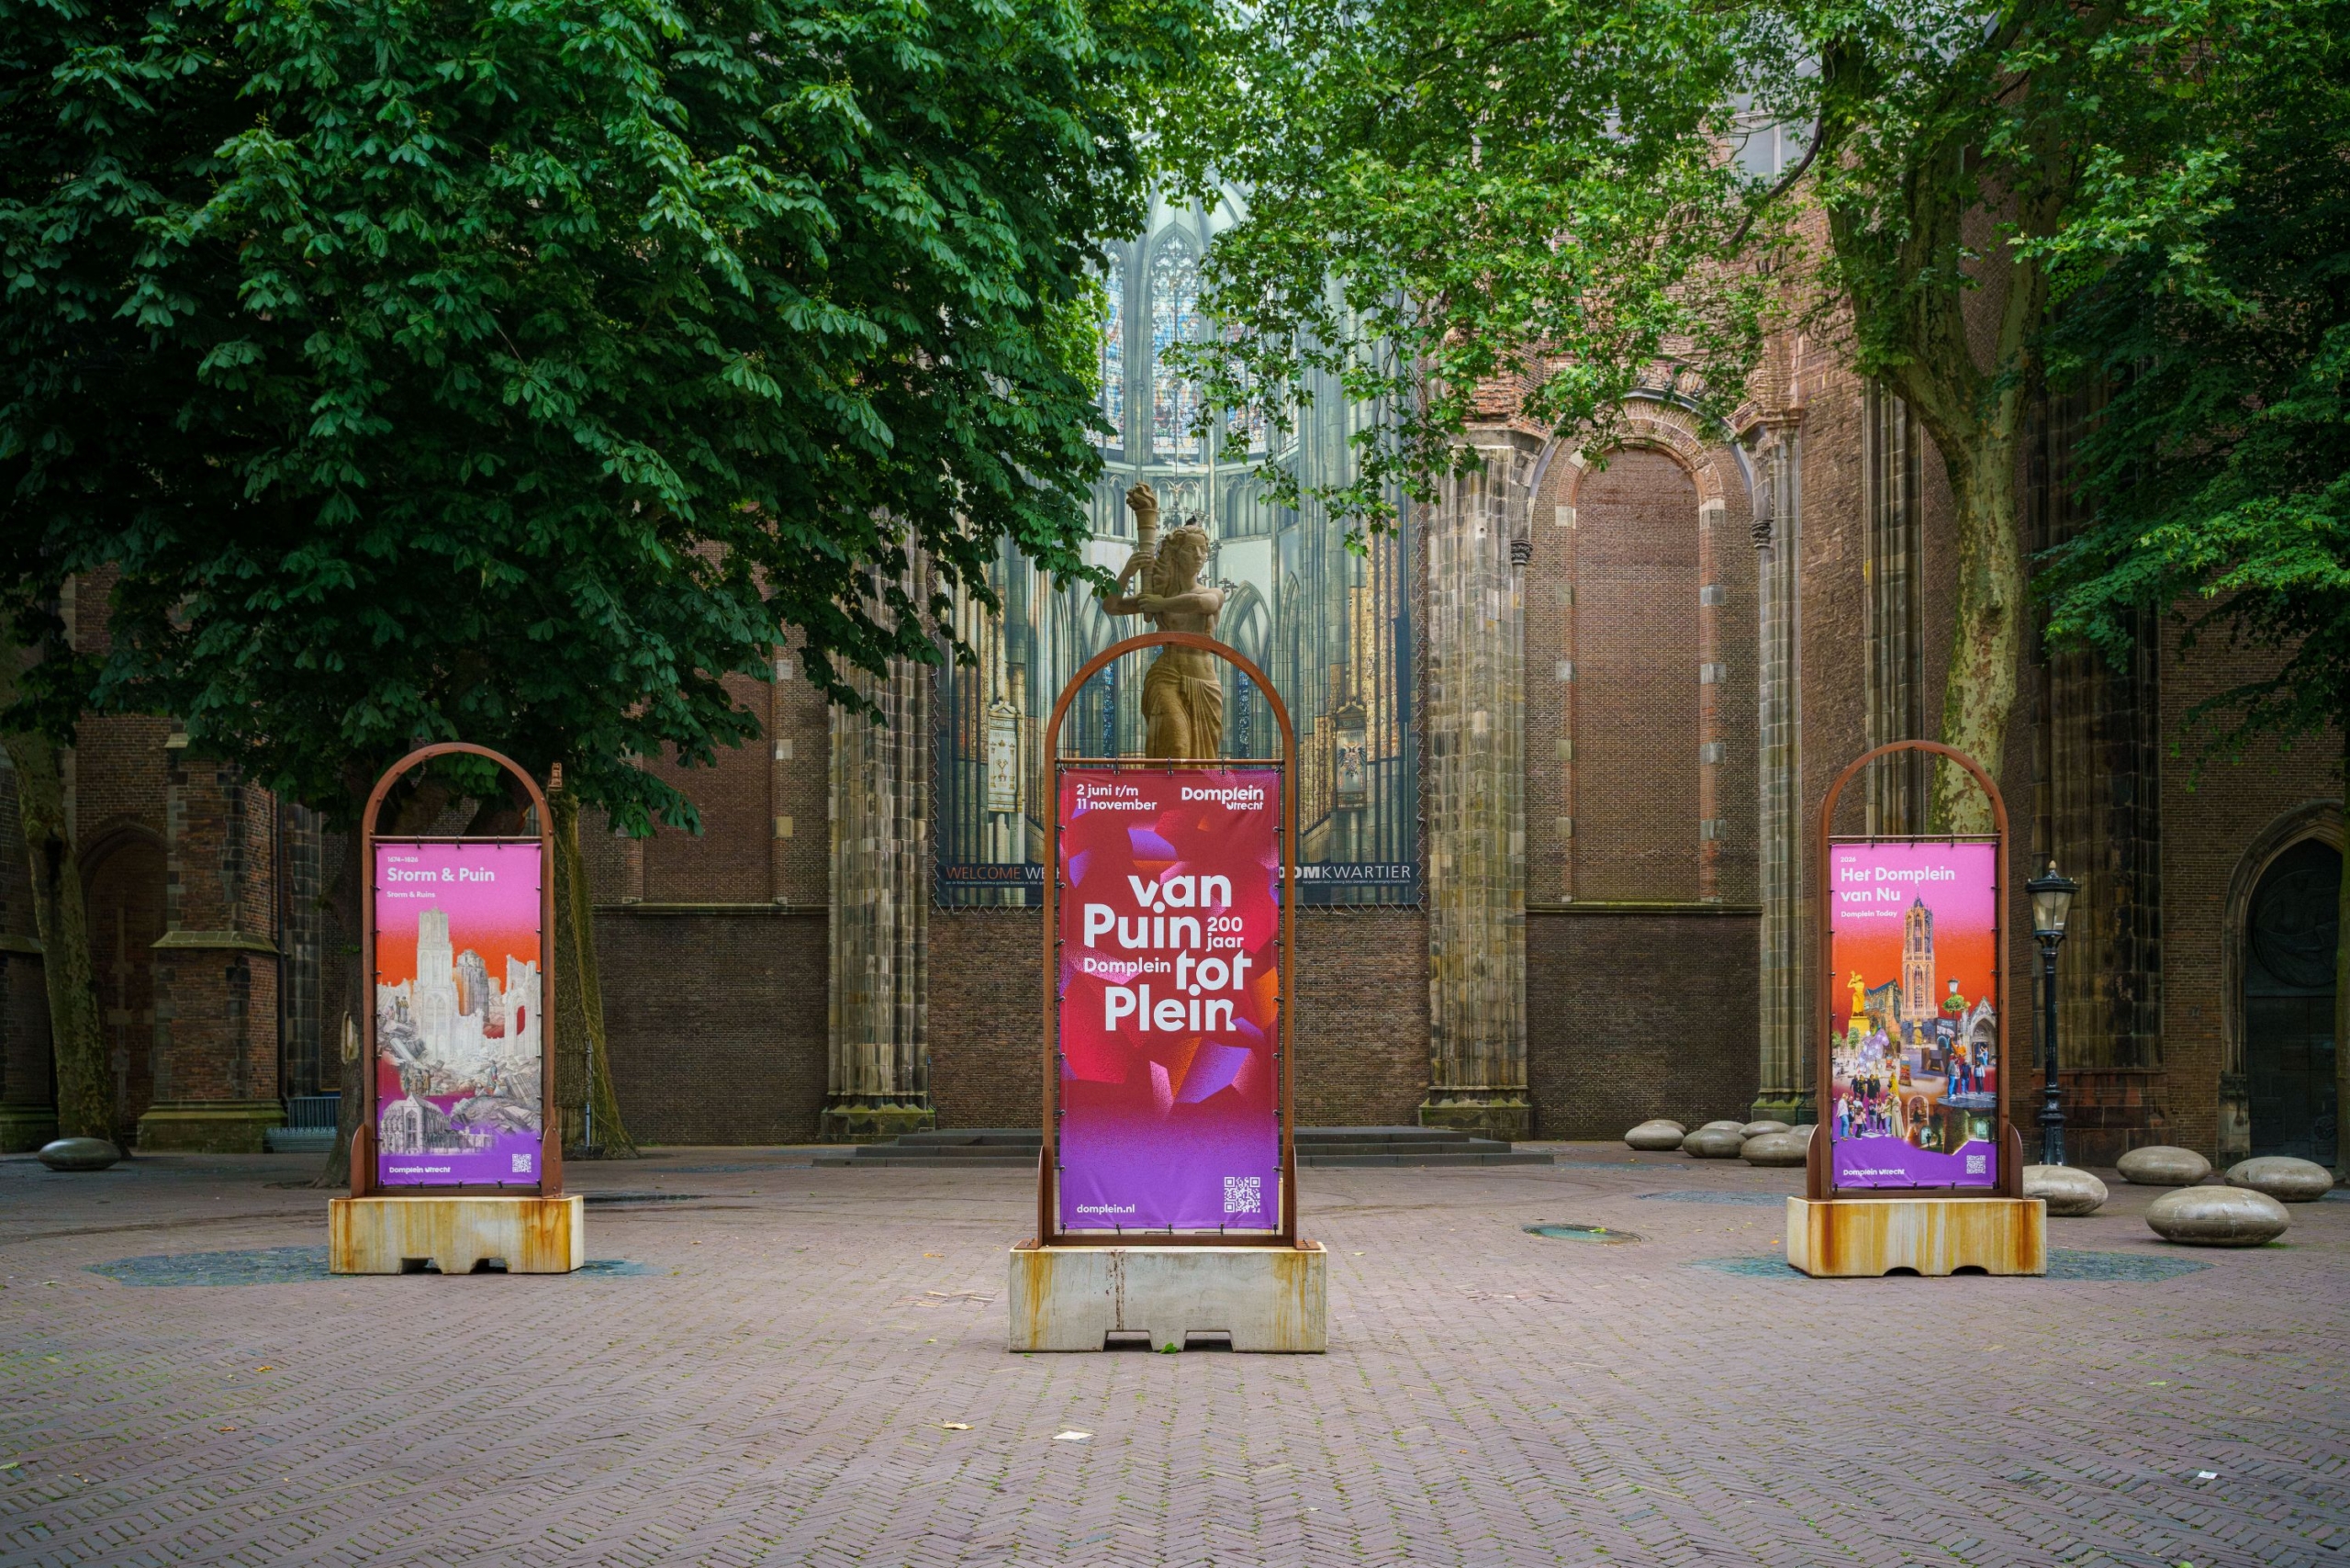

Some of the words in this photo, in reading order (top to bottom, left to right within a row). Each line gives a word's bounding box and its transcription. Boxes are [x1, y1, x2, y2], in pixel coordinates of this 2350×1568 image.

[1076, 784, 1085, 796] 2
[1087, 783, 1113, 799] juni
[1115, 784, 1139, 798] t/m
[1181, 784, 1264, 805] Domplein
[1076, 797, 1087, 810] 11
[1090, 798, 1158, 811] november
[386, 867, 437, 882] Storm
[441, 867, 455, 882] &
[459, 866, 495, 882] Puin
[946, 867, 1021, 879] WELCOME
[1841, 868, 1872, 882] Het
[1874, 866, 1955, 884] Domplein
[1127, 874, 1232, 908] van
[1840, 890, 1872, 902] van
[1876, 887, 1901, 902] Nu
[1841, 910, 1875, 919] Domplein
[1875, 910, 1897, 918] Today
[1083, 901, 1202, 949] Puin
[1207, 917, 1243, 932] 200
[1206, 933, 1245, 953] jaar
[1083, 957, 1171, 975] Domplein
[1176, 948, 1252, 991] tot
[1104, 983, 1237, 1032] Plein
[389, 1166, 424, 1175] Domplein
[1842, 1168, 1878, 1177] Domplein
[1076, 1204, 1136, 1215] domplein.nl
